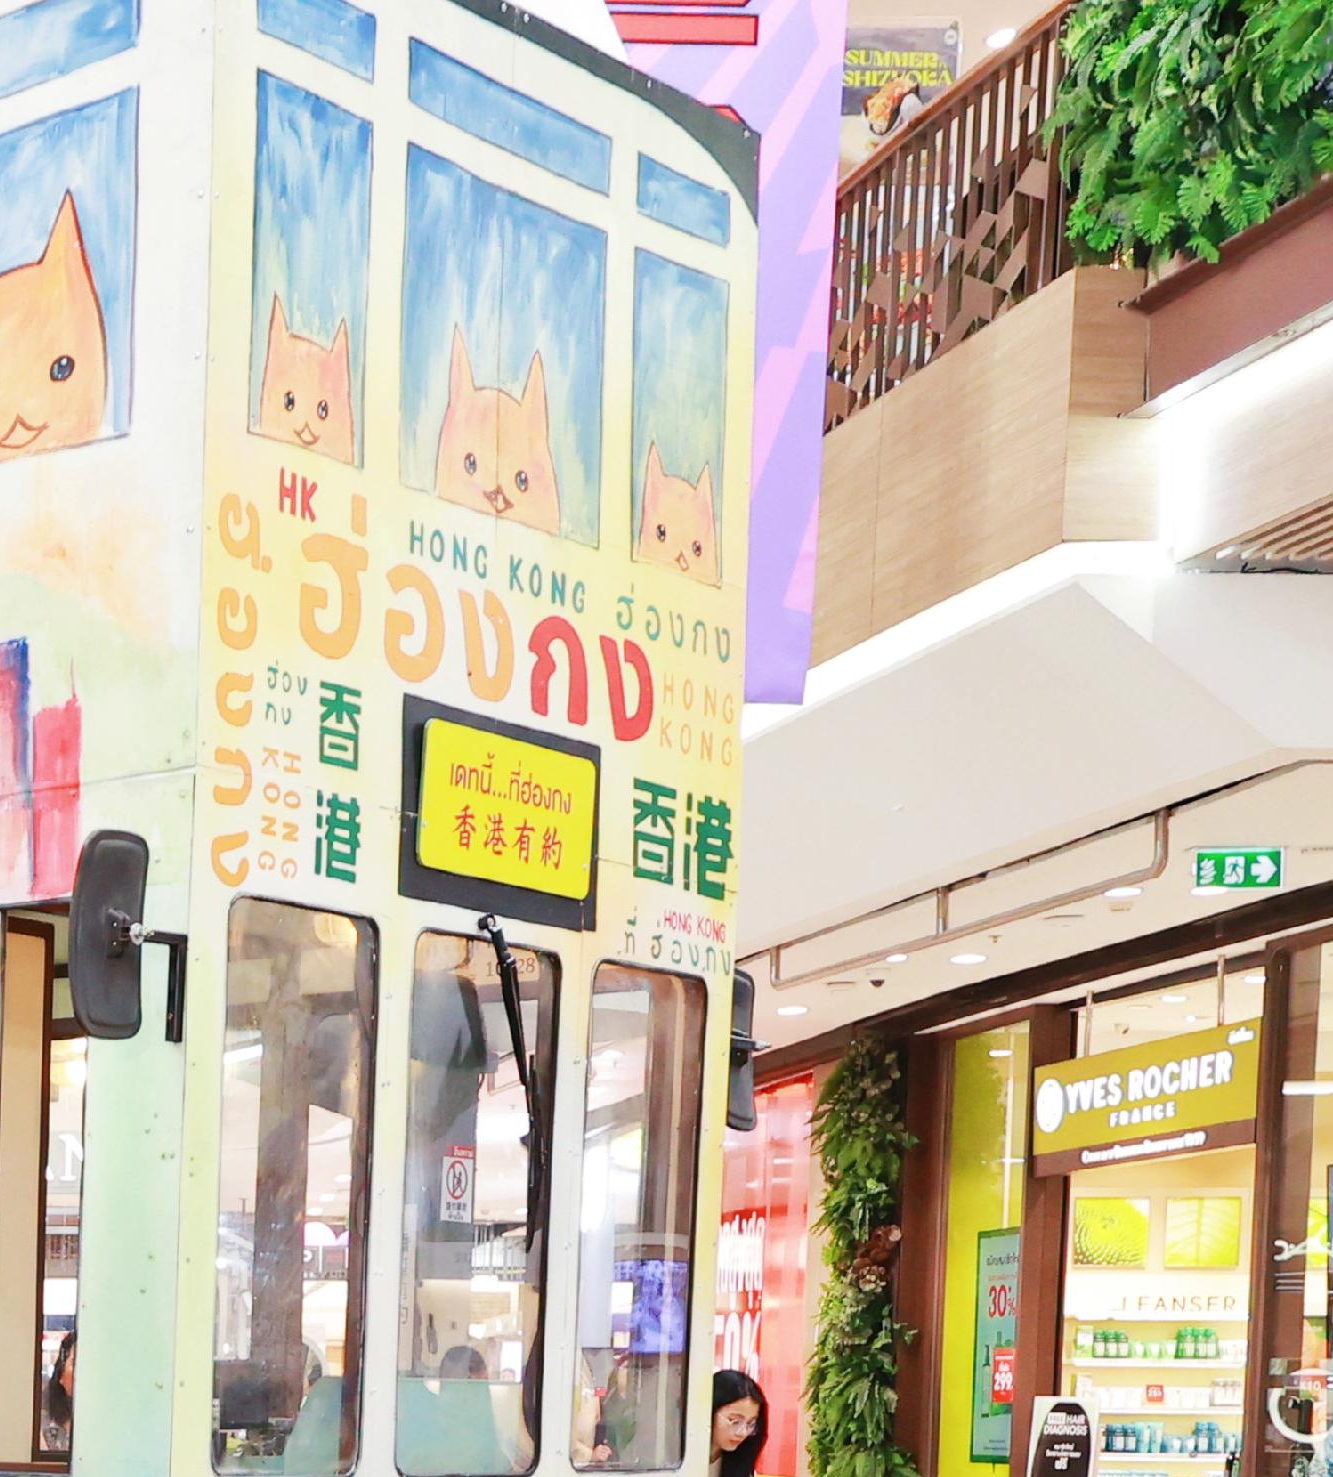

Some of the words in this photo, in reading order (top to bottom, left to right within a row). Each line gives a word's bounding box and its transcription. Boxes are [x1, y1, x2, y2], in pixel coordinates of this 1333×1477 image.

[845, 48, 939, 68] SUMMER
[278, 466, 317, 522] HK
[410, 520, 489, 580] HONG
[508, 554, 586, 615] KONG
[299, 494, 654, 743] ฮ่องกง
[615, 584, 731, 665] ฮ่องกง
[663, 673, 734, 724] HONG
[659, 714, 733, 769] KONG
[257, 745, 282, 874] KONG
[313, 680, 363, 885] 香港
[279, 752, 302, 881] HONG
[454, 805, 563, 872] 香港有約
[633, 777, 734, 902] 香港
[664, 908, 692, 935] HONG
[697, 915, 726, 944] KONG
[1065, 1073, 1122, 1114] YVES
[1128, 1050, 1233, 1101] ROCHER
[1109, 1101, 1176, 1128] FRANCE
[1044, 1425, 1087, 1436] DIAGNOSIS
[1066, 1414, 1086, 1424] HAIR
